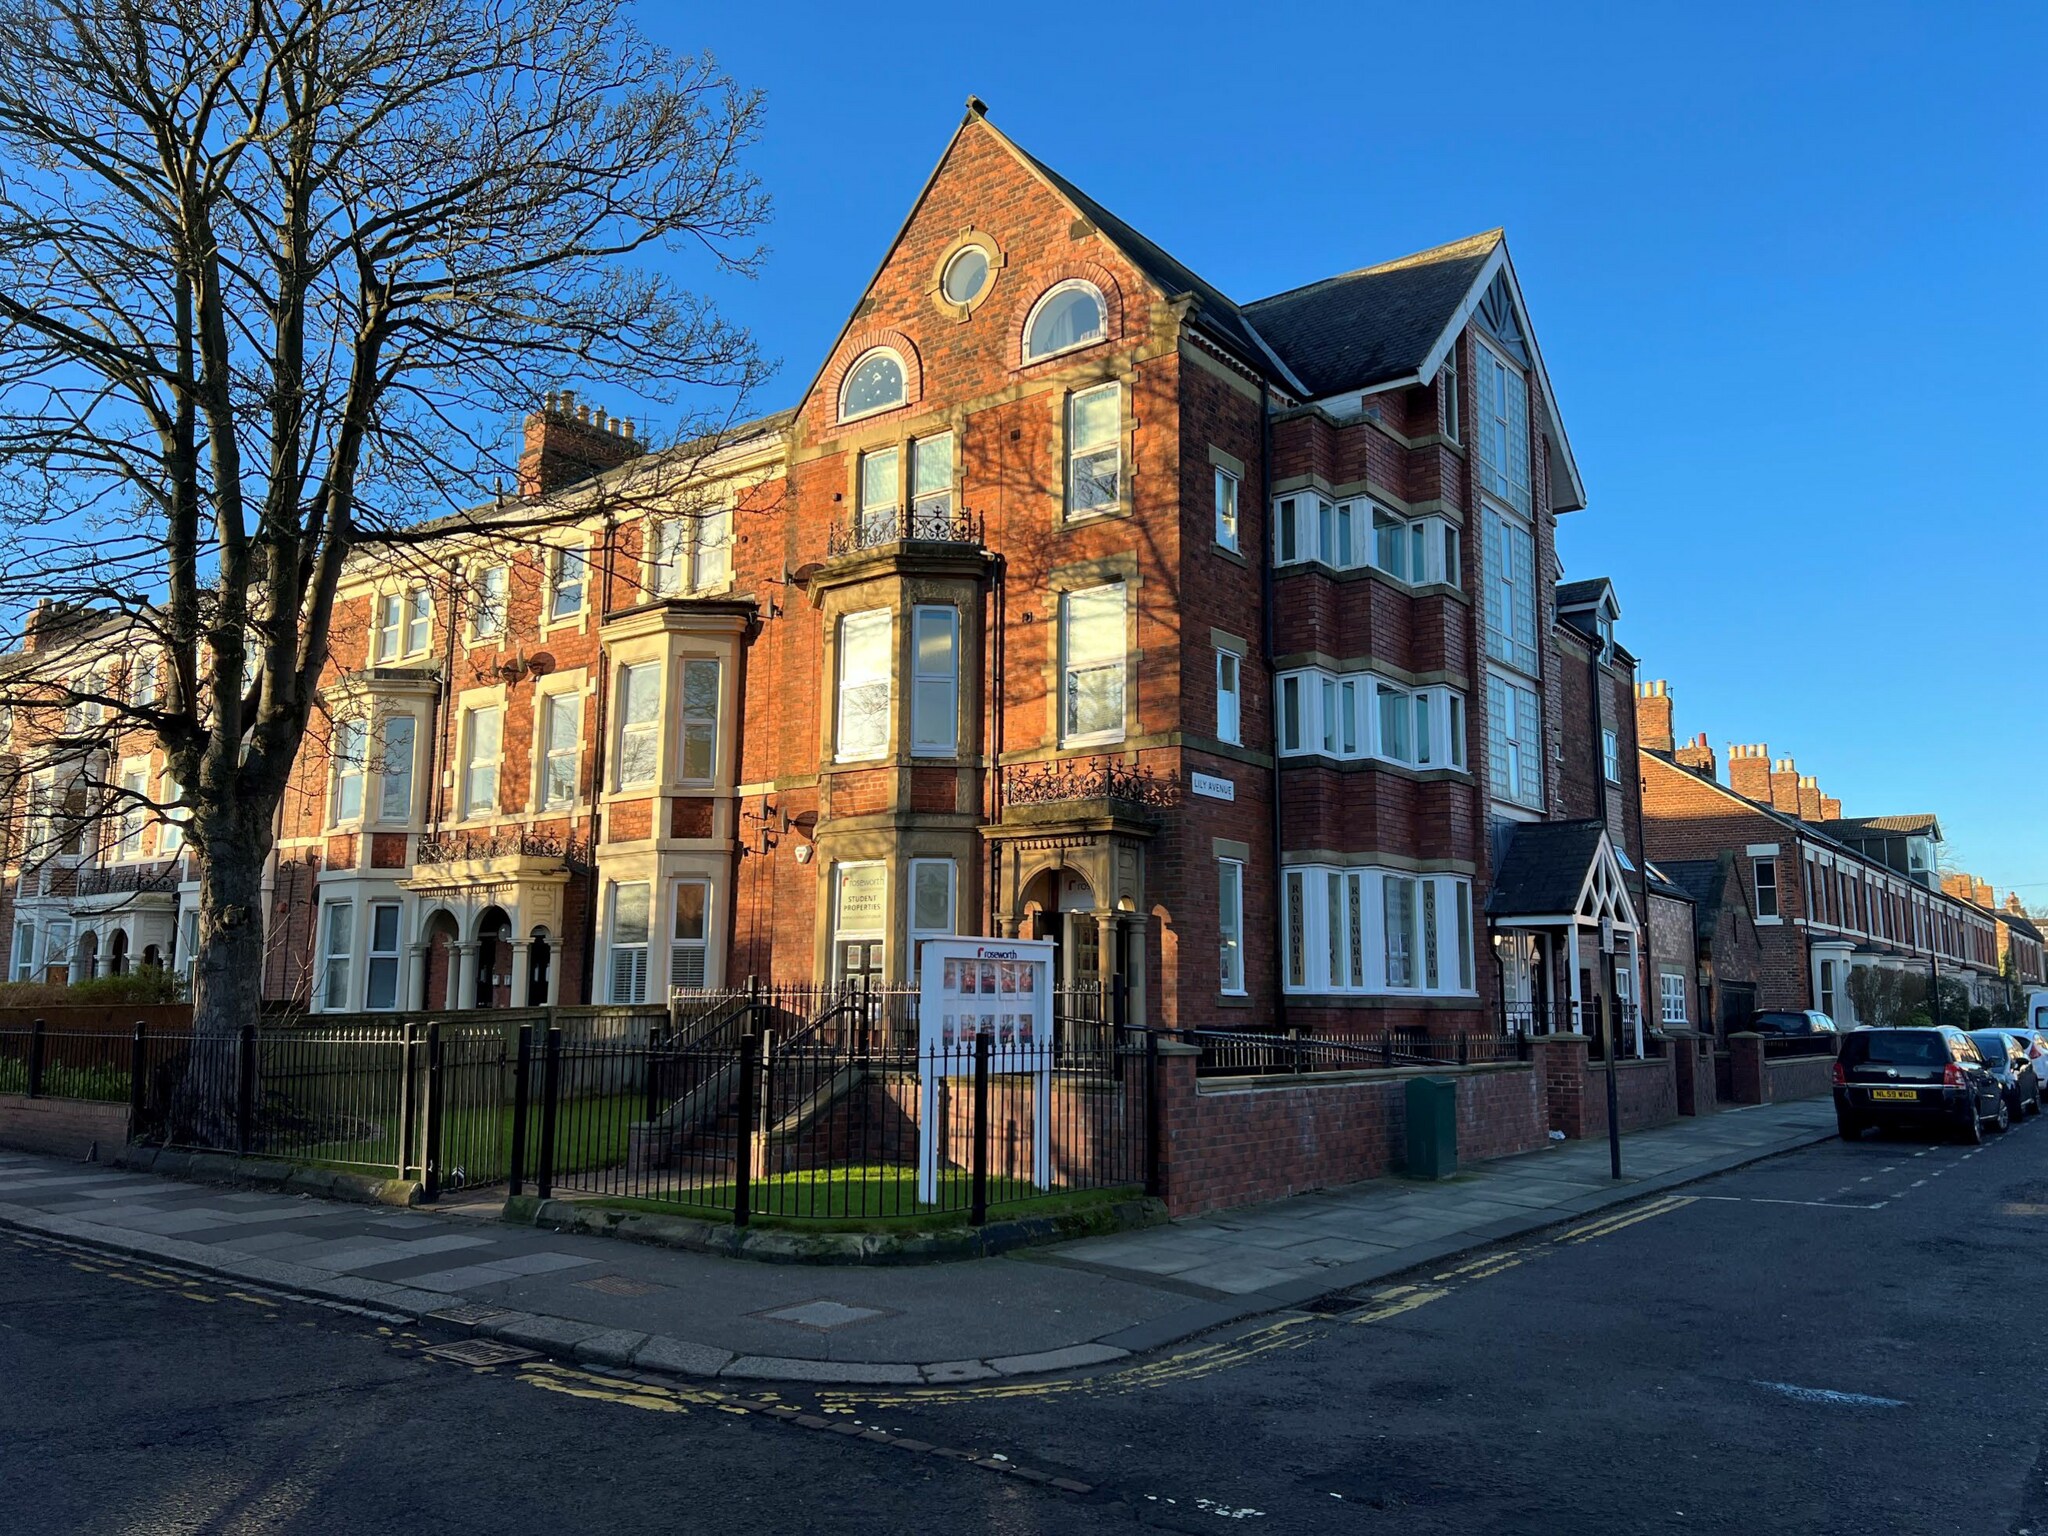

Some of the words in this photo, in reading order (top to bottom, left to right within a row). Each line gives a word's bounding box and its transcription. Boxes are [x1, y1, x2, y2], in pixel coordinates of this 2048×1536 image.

[1194, 778, 1207, 788] LILY
[1207, 782, 1232, 795] AVENUE
[849, 876, 884, 888] roseworth
[848, 895, 876, 903] STUDENT
[1291, 884, 1301, 975] ROSEWORTH
[1350, 886, 1361, 976] ROSEWORTH
[1425, 891, 1436, 978] ROSEWORTH
[984, 950, 1018, 959] roseworth
